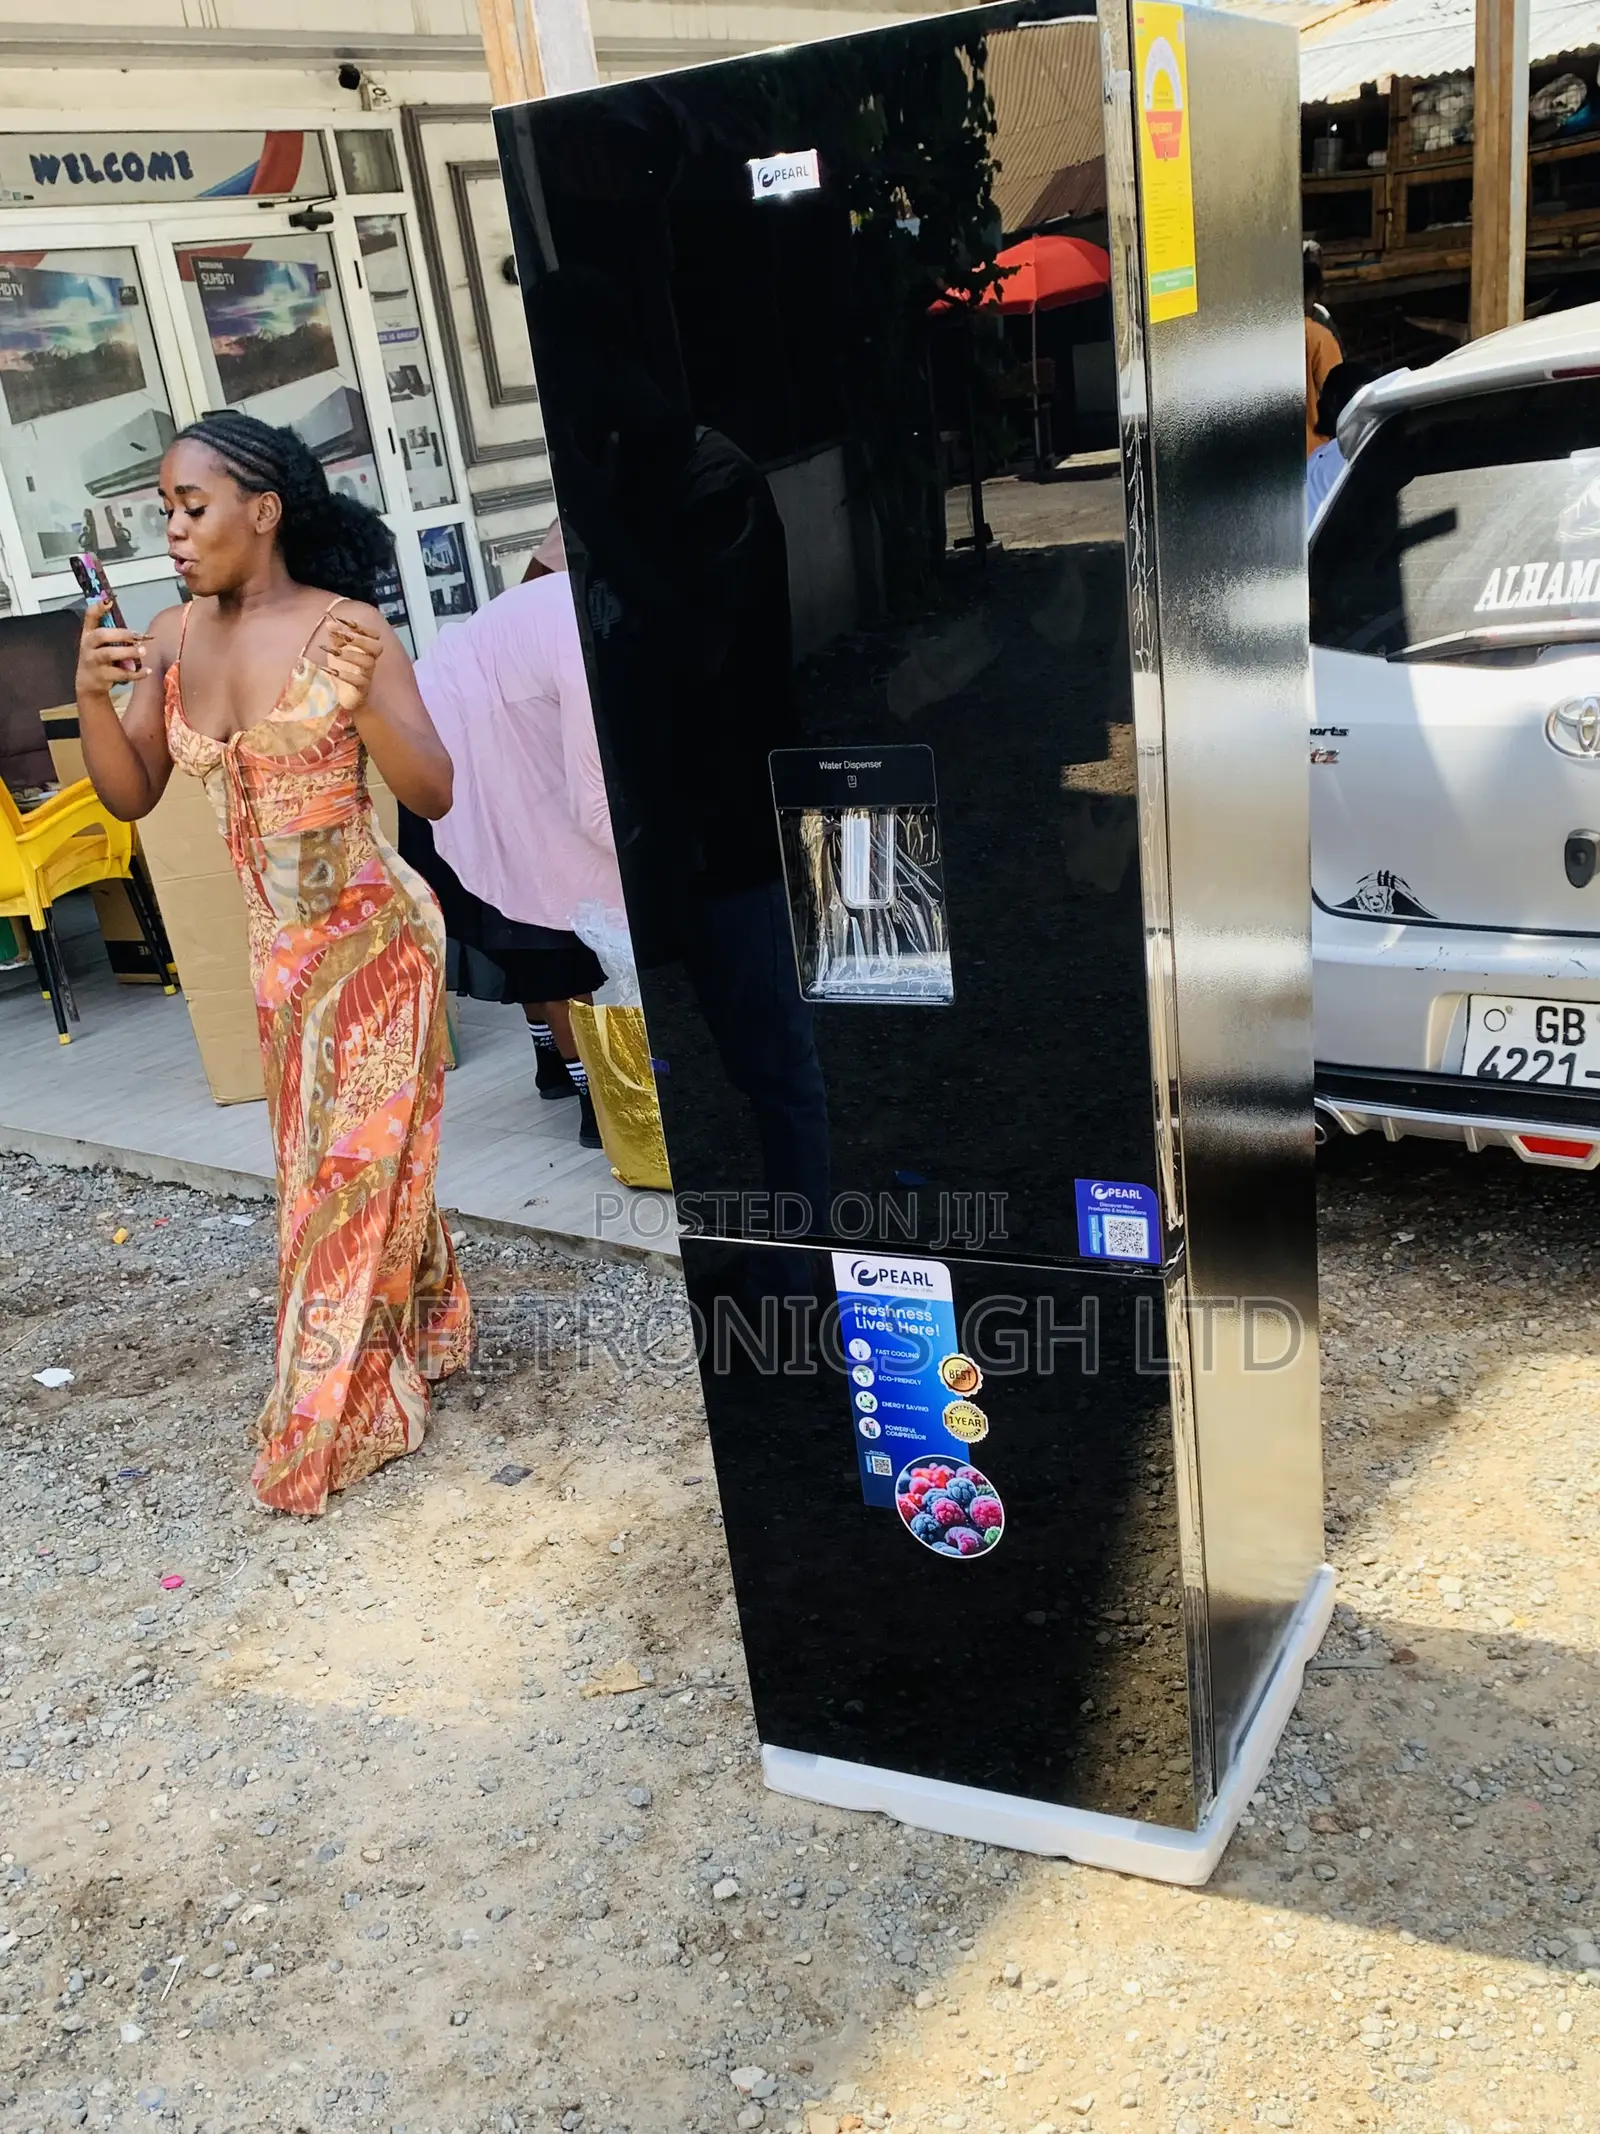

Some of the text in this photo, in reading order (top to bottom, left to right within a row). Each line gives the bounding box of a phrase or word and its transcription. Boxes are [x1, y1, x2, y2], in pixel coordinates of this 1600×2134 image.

[29, 150, 194, 185] WELCOME
[774, 165, 809, 181] PEARL
[1474, 559, 1600, 611] ALHAM
[819, 760, 882, 770] Water Dispenser
[1536, 1006, 1586, 1046] GB
[1107, 1187, 1142, 1200] PEARL
[879, 1268, 934, 1287] PEARL
[853, 1302, 933, 1322] Freshness
[855, 1316, 941, 1337] Lives Here!
[875, 1348, 920, 1359] FAST COOLING
[878, 1375, 921, 1386] ECO-FRIENDLY
[948, 1369, 972, 1381] BEST
[881, 1401, 929, 1412] ENERGY SAVING
[955, 1416, 982, 1428] YEAR
[885, 1424, 916, 1434] POWERFUL
[885, 1430, 927, 1441] COMPRESSOR
